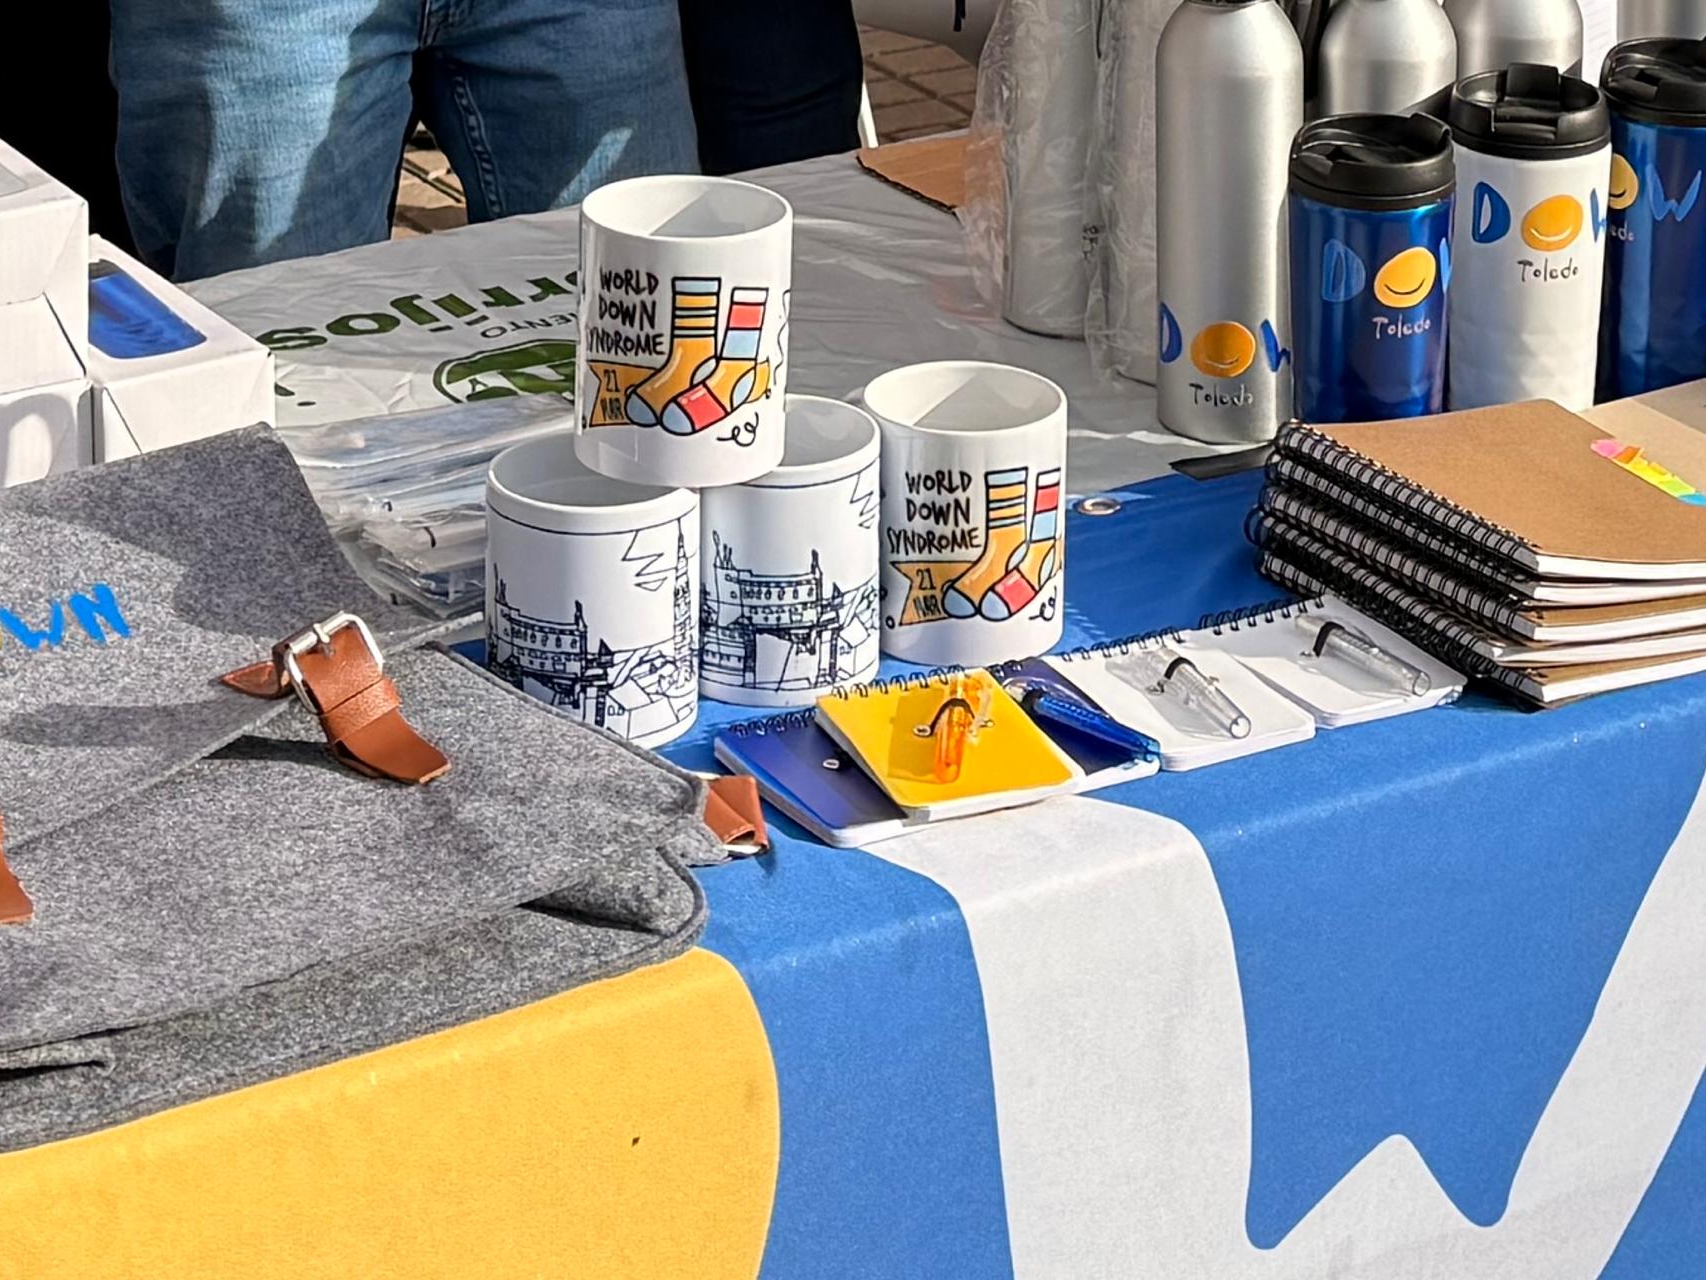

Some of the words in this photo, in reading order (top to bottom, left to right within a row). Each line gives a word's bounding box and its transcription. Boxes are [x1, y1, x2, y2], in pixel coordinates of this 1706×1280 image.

[599, 267, 659, 295] WORLD
[1516, 256, 1579, 282] Toledo
[598, 293, 657, 331] DOWN
[1372, 313, 1432, 339] Toledo
[603, 368, 620, 393] 21
[1188, 382, 1255, 408] Toledo
[905, 468, 973, 496] WORLD
[906, 497, 971, 528] DOWN
[886, 526, 982, 557] SYNDROME
[915, 567, 936, 591] 21
